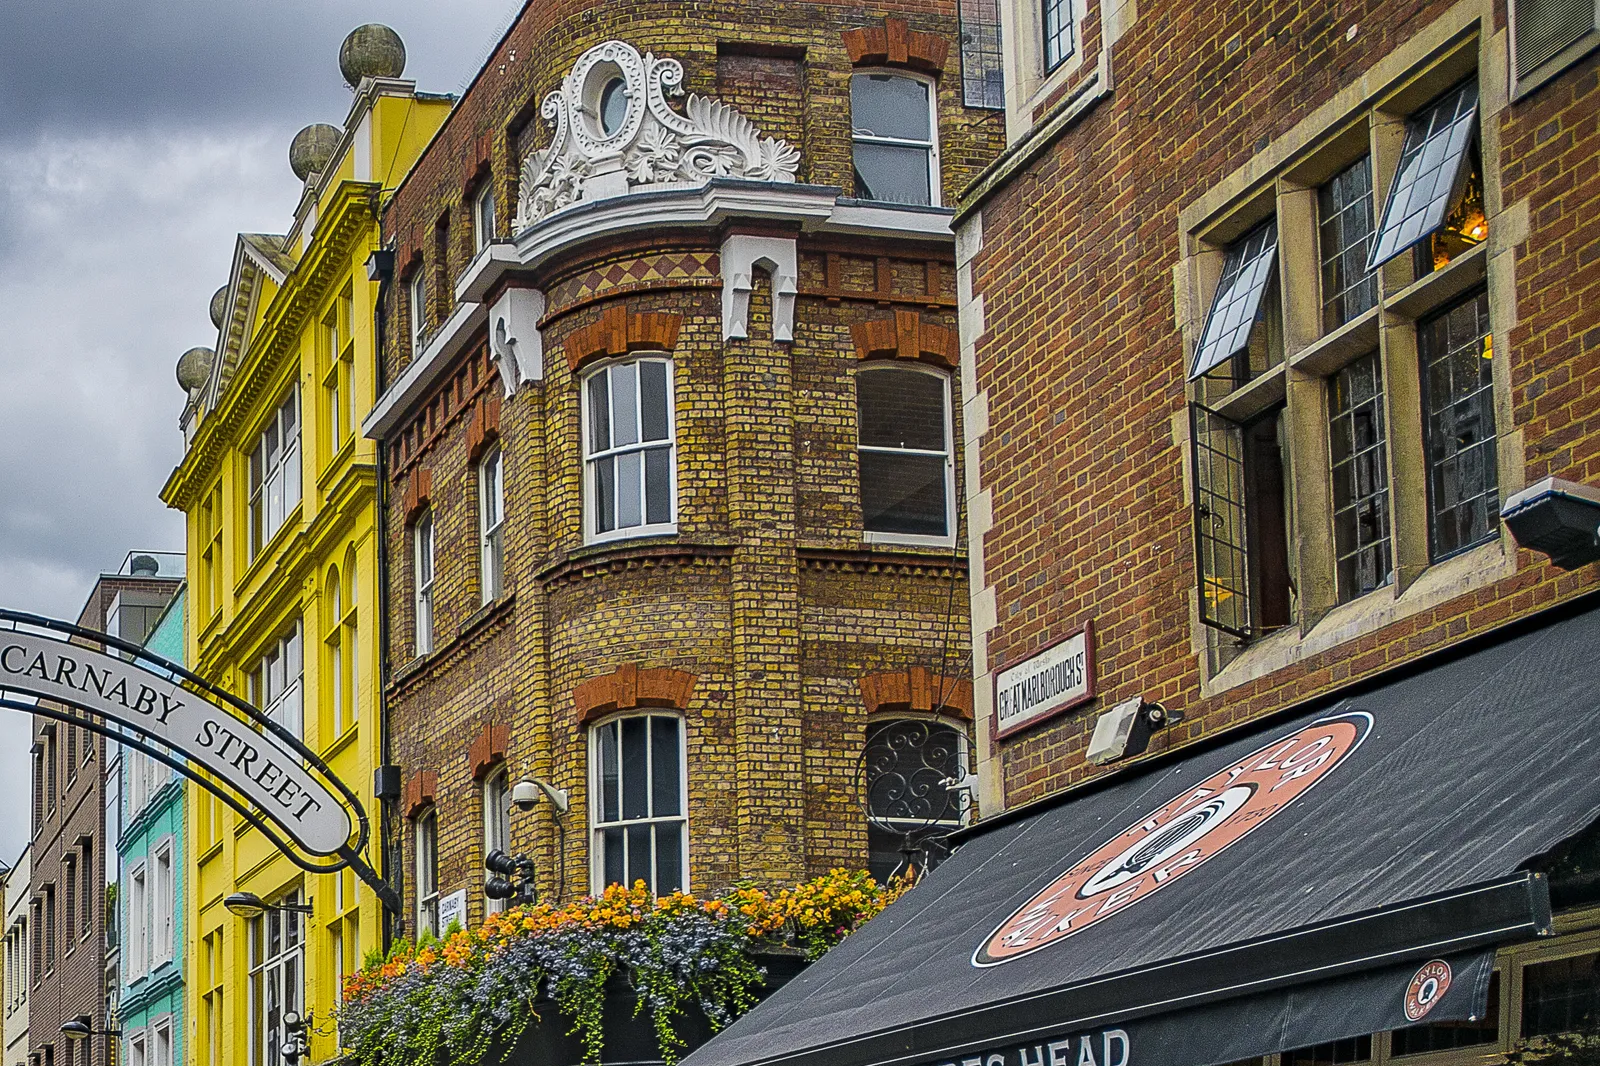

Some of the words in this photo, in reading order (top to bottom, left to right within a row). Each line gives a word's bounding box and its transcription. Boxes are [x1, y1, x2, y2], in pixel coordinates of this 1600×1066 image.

[999, 682, 1021, 721] GREAT
[1021, 656, 1075, 711] MARLBOROUGH
[0, 645, 185, 726] CARNABY
[195, 720, 321, 822] STREET
[1127, 733, 1336, 838] TAYLOR
[1001, 848, 1206, 948] WALKER
[1408, 995, 1439, 1017] WALKER
[1413, 965, 1447, 985] TAYLOR
